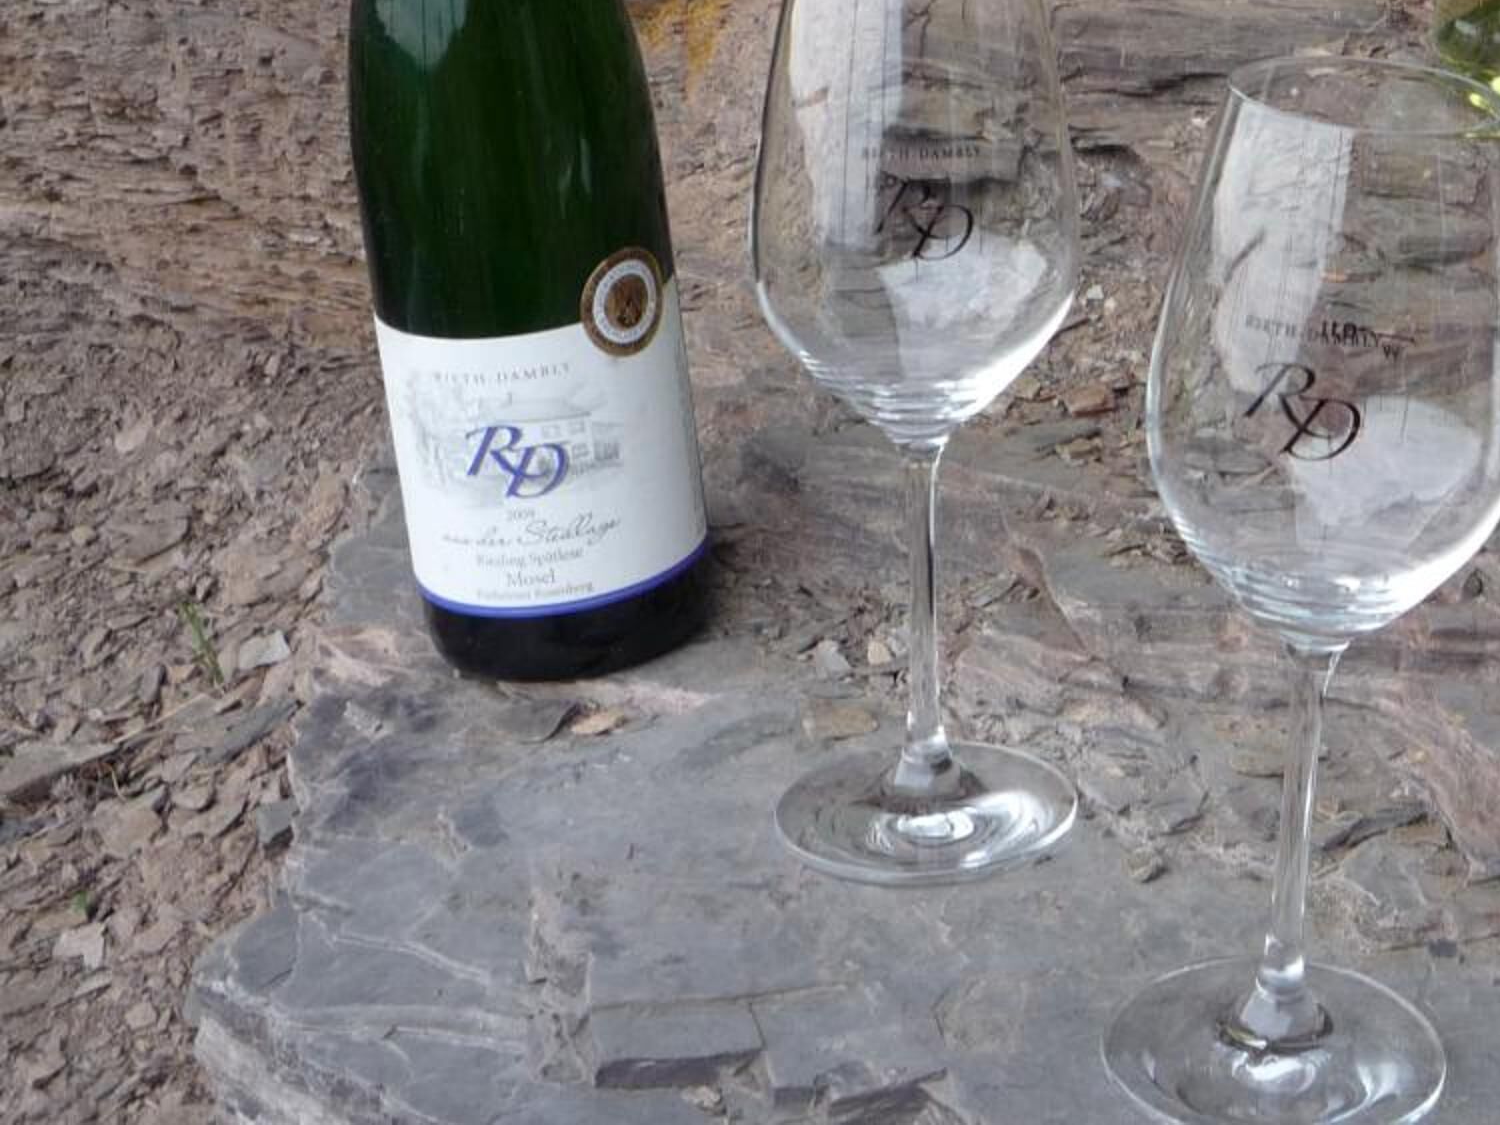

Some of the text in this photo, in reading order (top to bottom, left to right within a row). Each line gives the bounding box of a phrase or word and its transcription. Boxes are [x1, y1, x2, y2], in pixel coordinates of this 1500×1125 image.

[1244, 362, 1361, 461] RD
[465, 425, 570, 499] RD
[507, 569, 556, 587] Mosel
